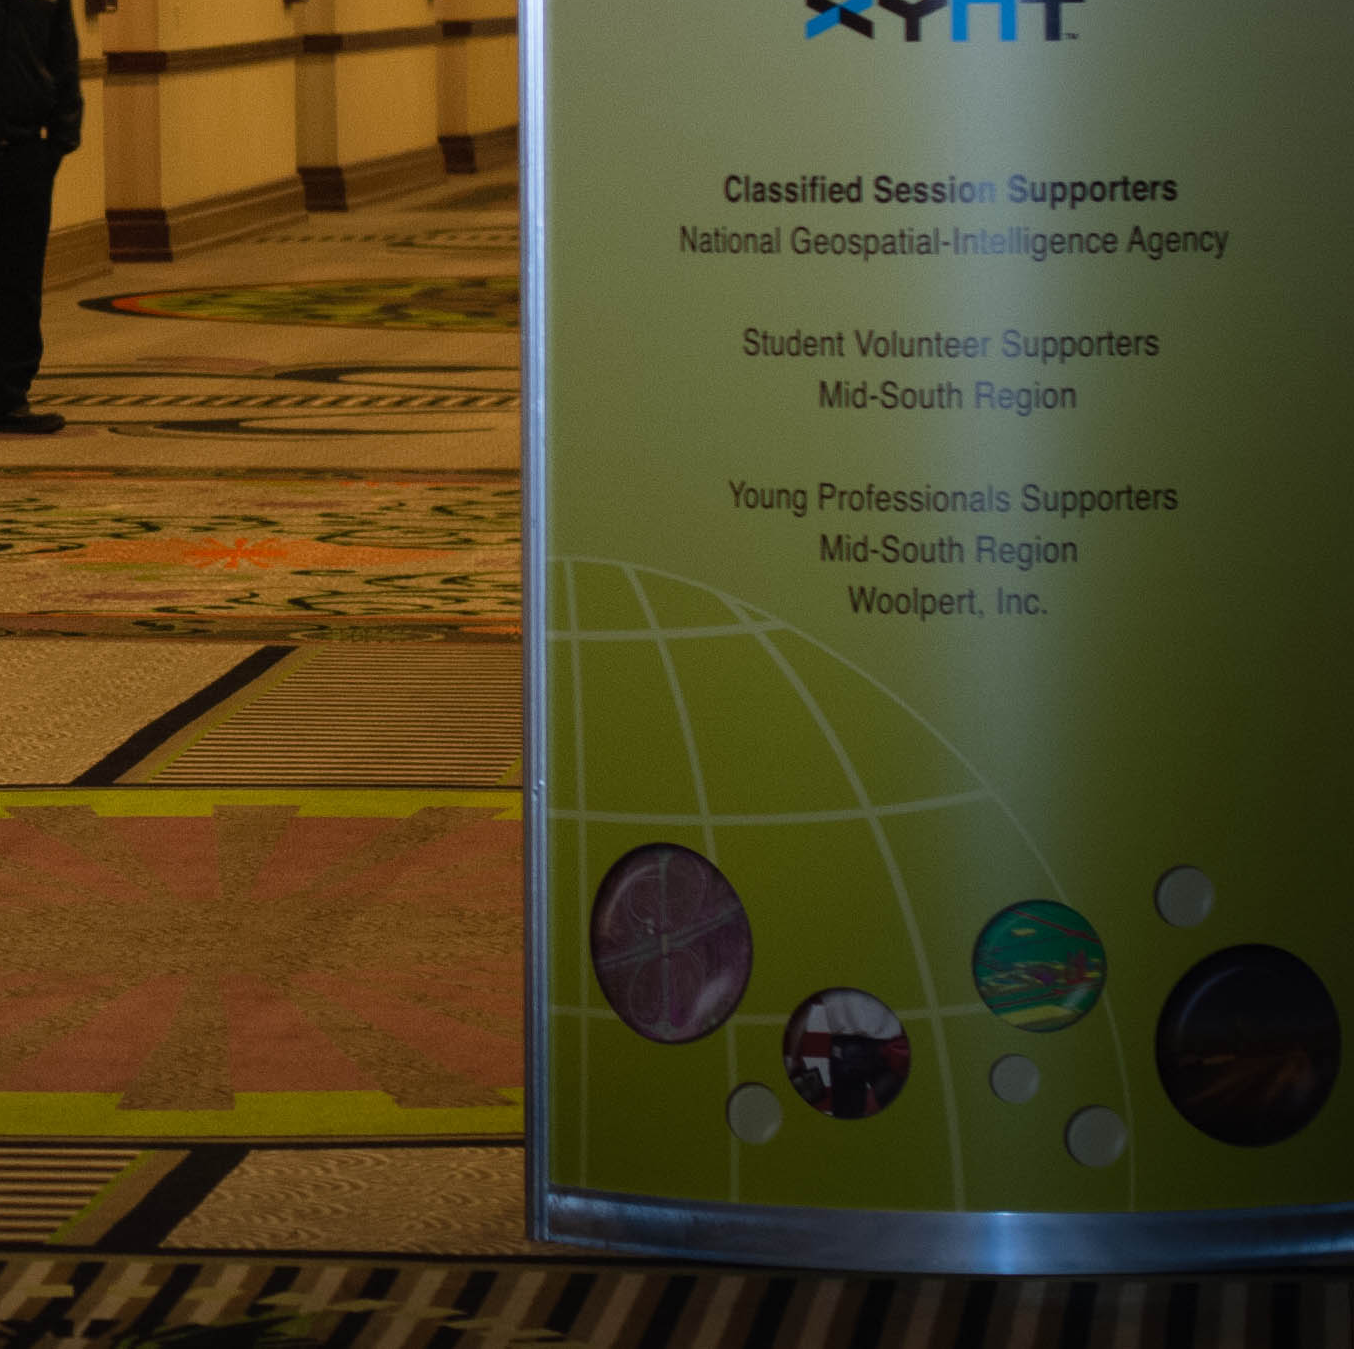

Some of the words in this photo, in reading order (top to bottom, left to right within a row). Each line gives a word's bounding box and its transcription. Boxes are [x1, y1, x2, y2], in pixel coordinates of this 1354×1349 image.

[724, 176, 863, 205] Classified
[873, 176, 996, 204] Session
[1008, 174, 1178, 210] Supporters
[680, 226, 781, 255] National
[790, 225, 1118, 262] Geospatial-Intelligence
[1127, 225, 1229, 260] Agency
[742, 329, 844, 357] Student
[855, 331, 990, 359] Volunteer
[1001, 329, 1160, 364] Supporters
[818, 381, 963, 410] Mid-South
[974, 381, 1077, 417] Region
[729, 481, 807, 518] Young
[818, 483, 1010, 515] Professionals
[1021, 484, 1179, 518] Supporters
[820, 534, 965, 565] Mid-South
[974, 536, 1079, 571] Region
[848, 586, 984, 621] Woolpert,
[997, 587, 1048, 615] Inc.
